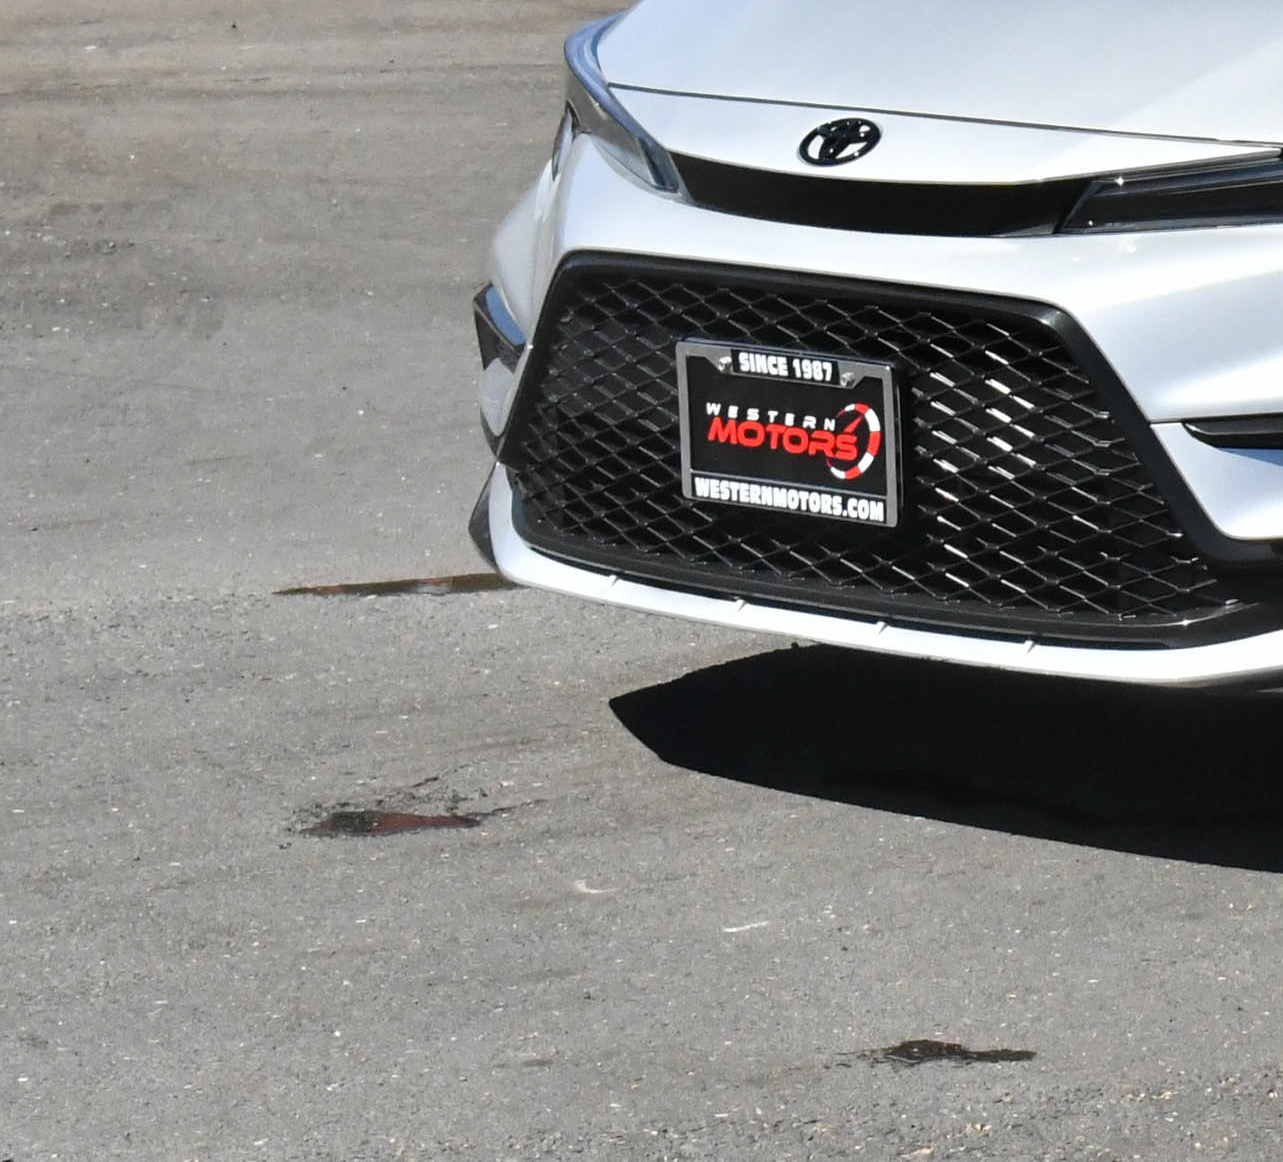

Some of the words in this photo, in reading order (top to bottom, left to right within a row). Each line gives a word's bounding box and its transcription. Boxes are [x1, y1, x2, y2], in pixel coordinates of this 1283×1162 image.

[738, 351, 789, 377] SINCE
[792, 357, 834, 383] 1987
[706, 402, 836, 432] WESTERN
[707, 416, 859, 461] MOTORS
[694, 476, 885, 523] WESTERNMOTORS.COM
